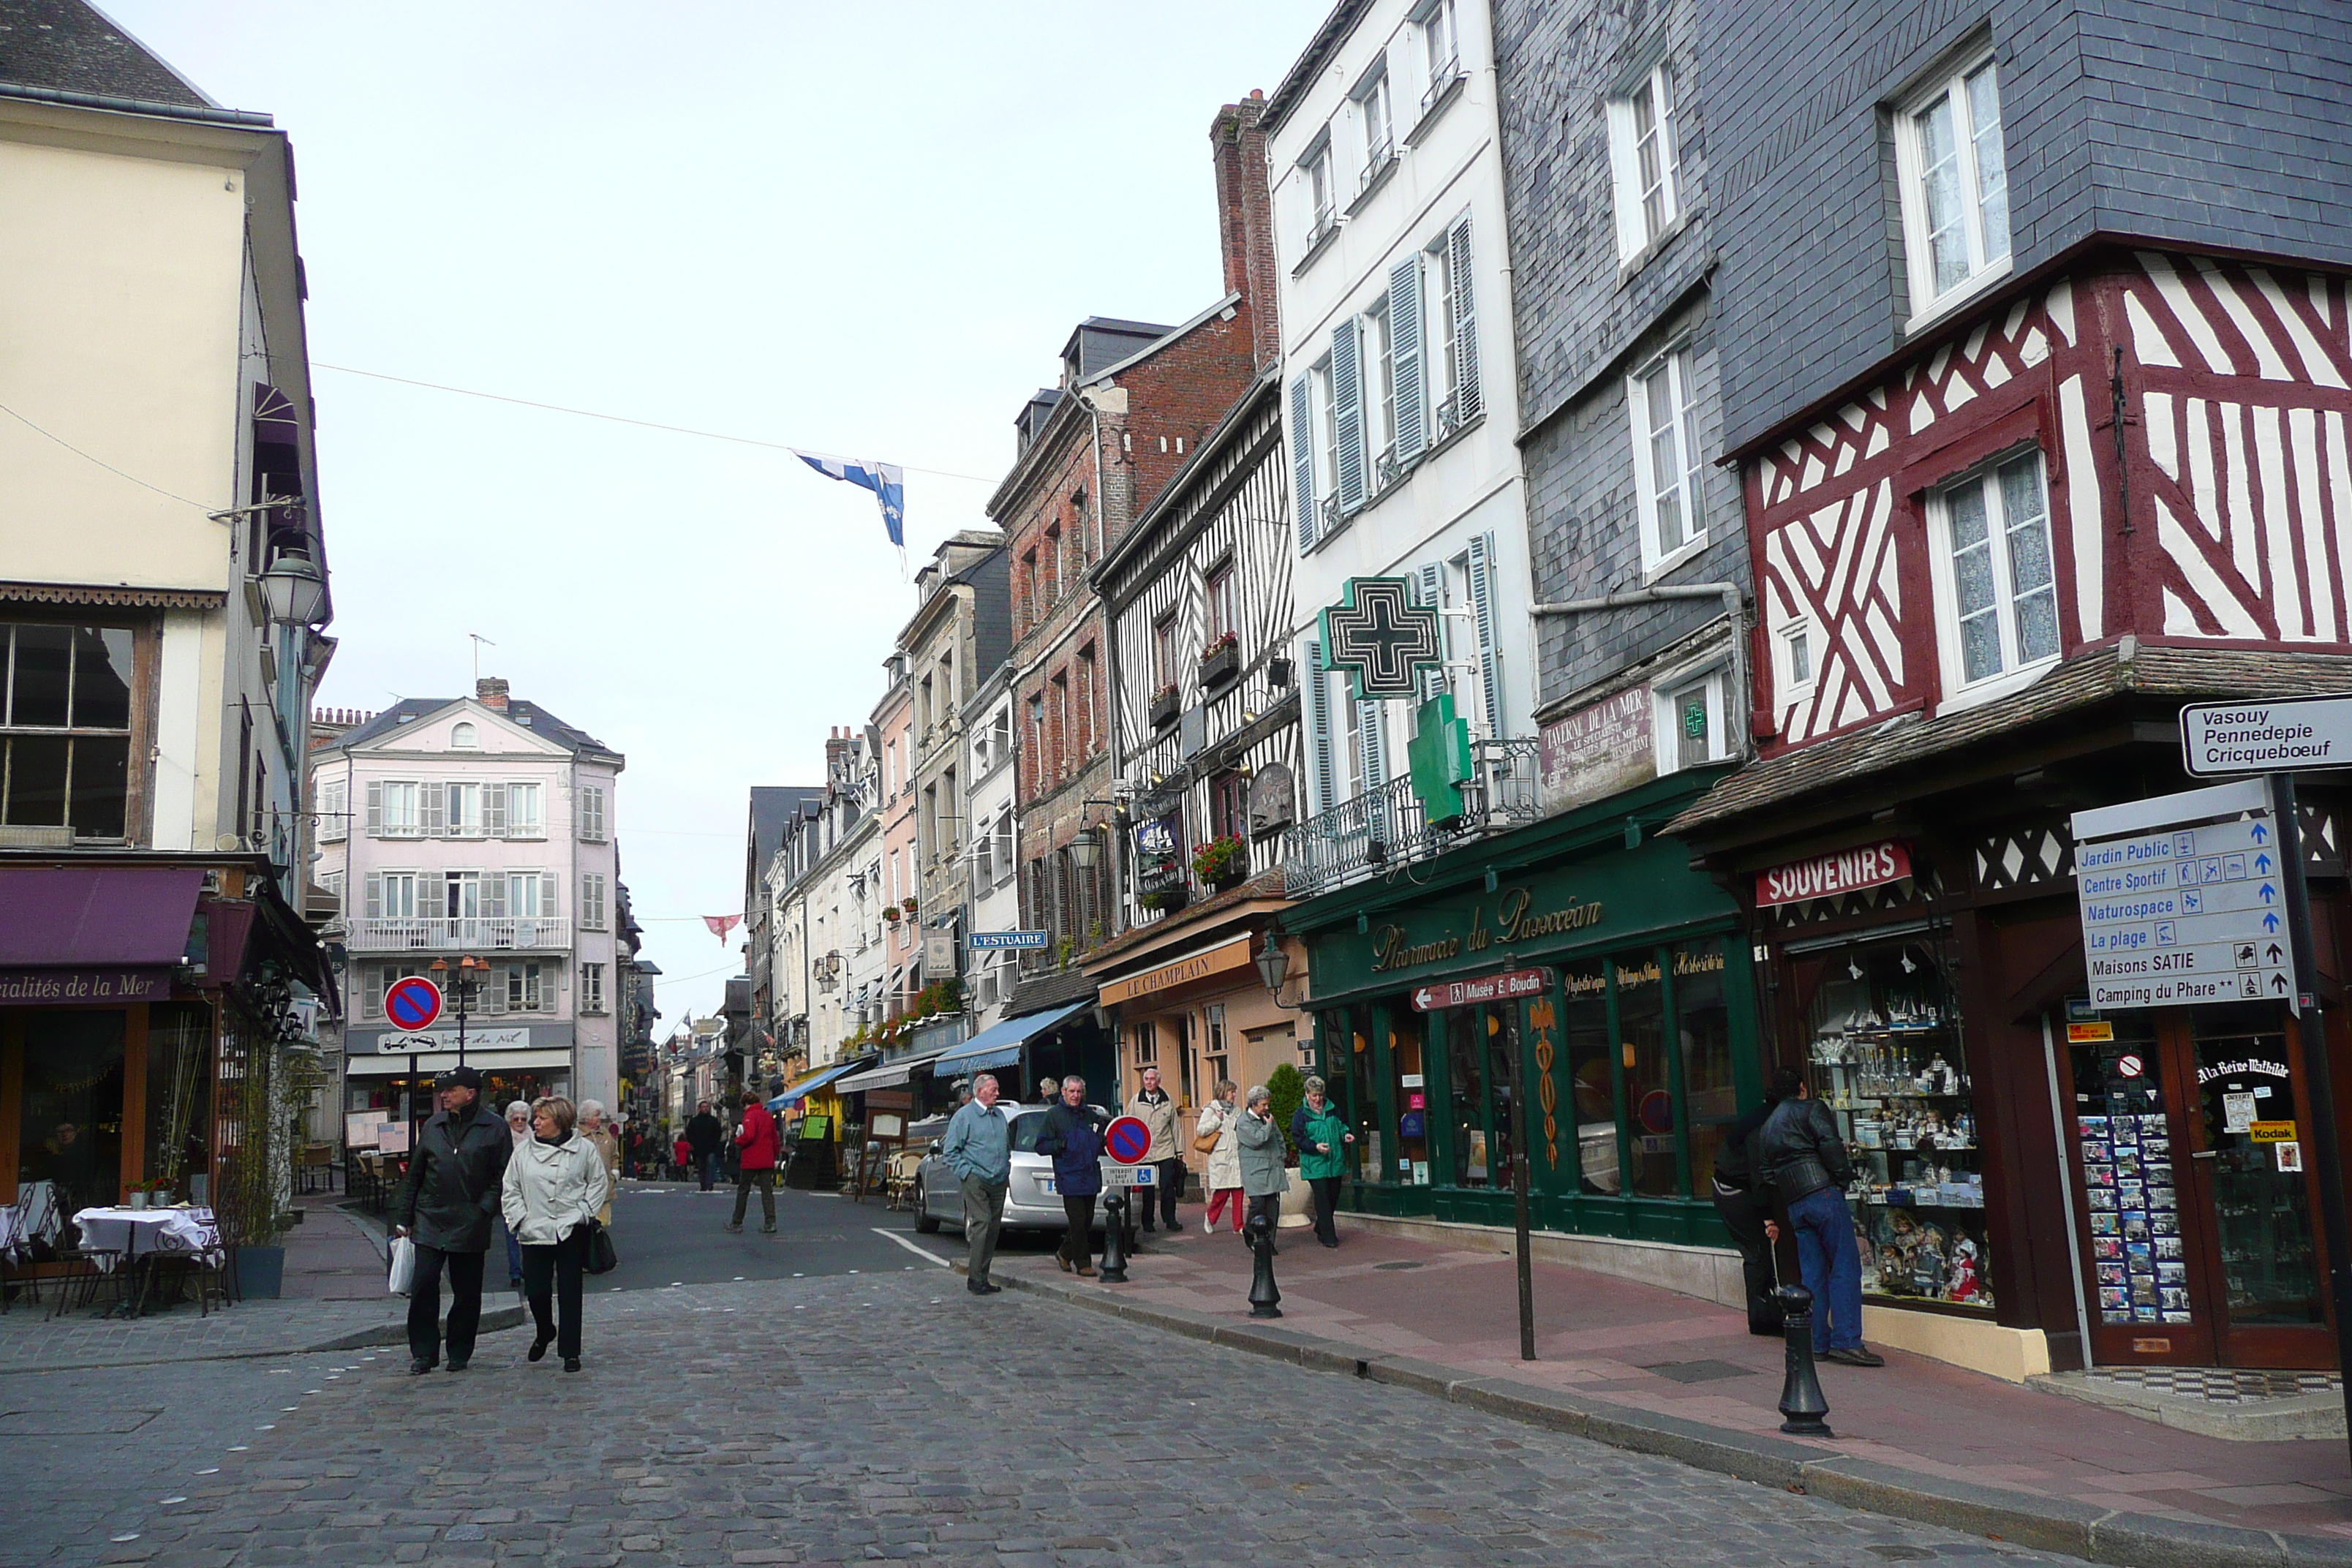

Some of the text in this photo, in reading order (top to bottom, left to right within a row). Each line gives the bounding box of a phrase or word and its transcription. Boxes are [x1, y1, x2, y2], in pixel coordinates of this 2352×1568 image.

[1588, 707, 1601, 732] DE
[1602, 701, 1616, 724] LA
[1619, 688, 1643, 717] MER
[2203, 709, 2269, 725] Vasouy
[2204, 723, 2313, 745] Pennedepie
[2081, 841, 2169, 867] Jardin Public
[1767, 842, 1895, 900] SOUVENIRS
[2084, 868, 2167, 894] Centre Sportif
[2088, 900, 2173, 921] Naturospace
[973, 934, 1042, 946] L'ESTUAIRE
[1371, 924, 1459, 971] Pharmacie
[1467, 906, 1489, 951] du
[2091, 931, 2146, 950] La plage
[2092, 952, 2194, 976] Maisons SATIE
[0, 974, 154, 998] ialités de la Mer
[1127, 957, 1209, 997] LE CHAMPLAIN
[1466, 981, 1493, 999] Musée
[1510, 974, 1539, 992] Boudin
[2096, 981, 2216, 1005] Camping du Phare
[2204, 1066, 2220, 1079] la
[2217, 1060, 2248, 1075] Reine
[2247, 1058, 2289, 1078] Mathilde
[2254, 1128, 2292, 1139] Kodak
